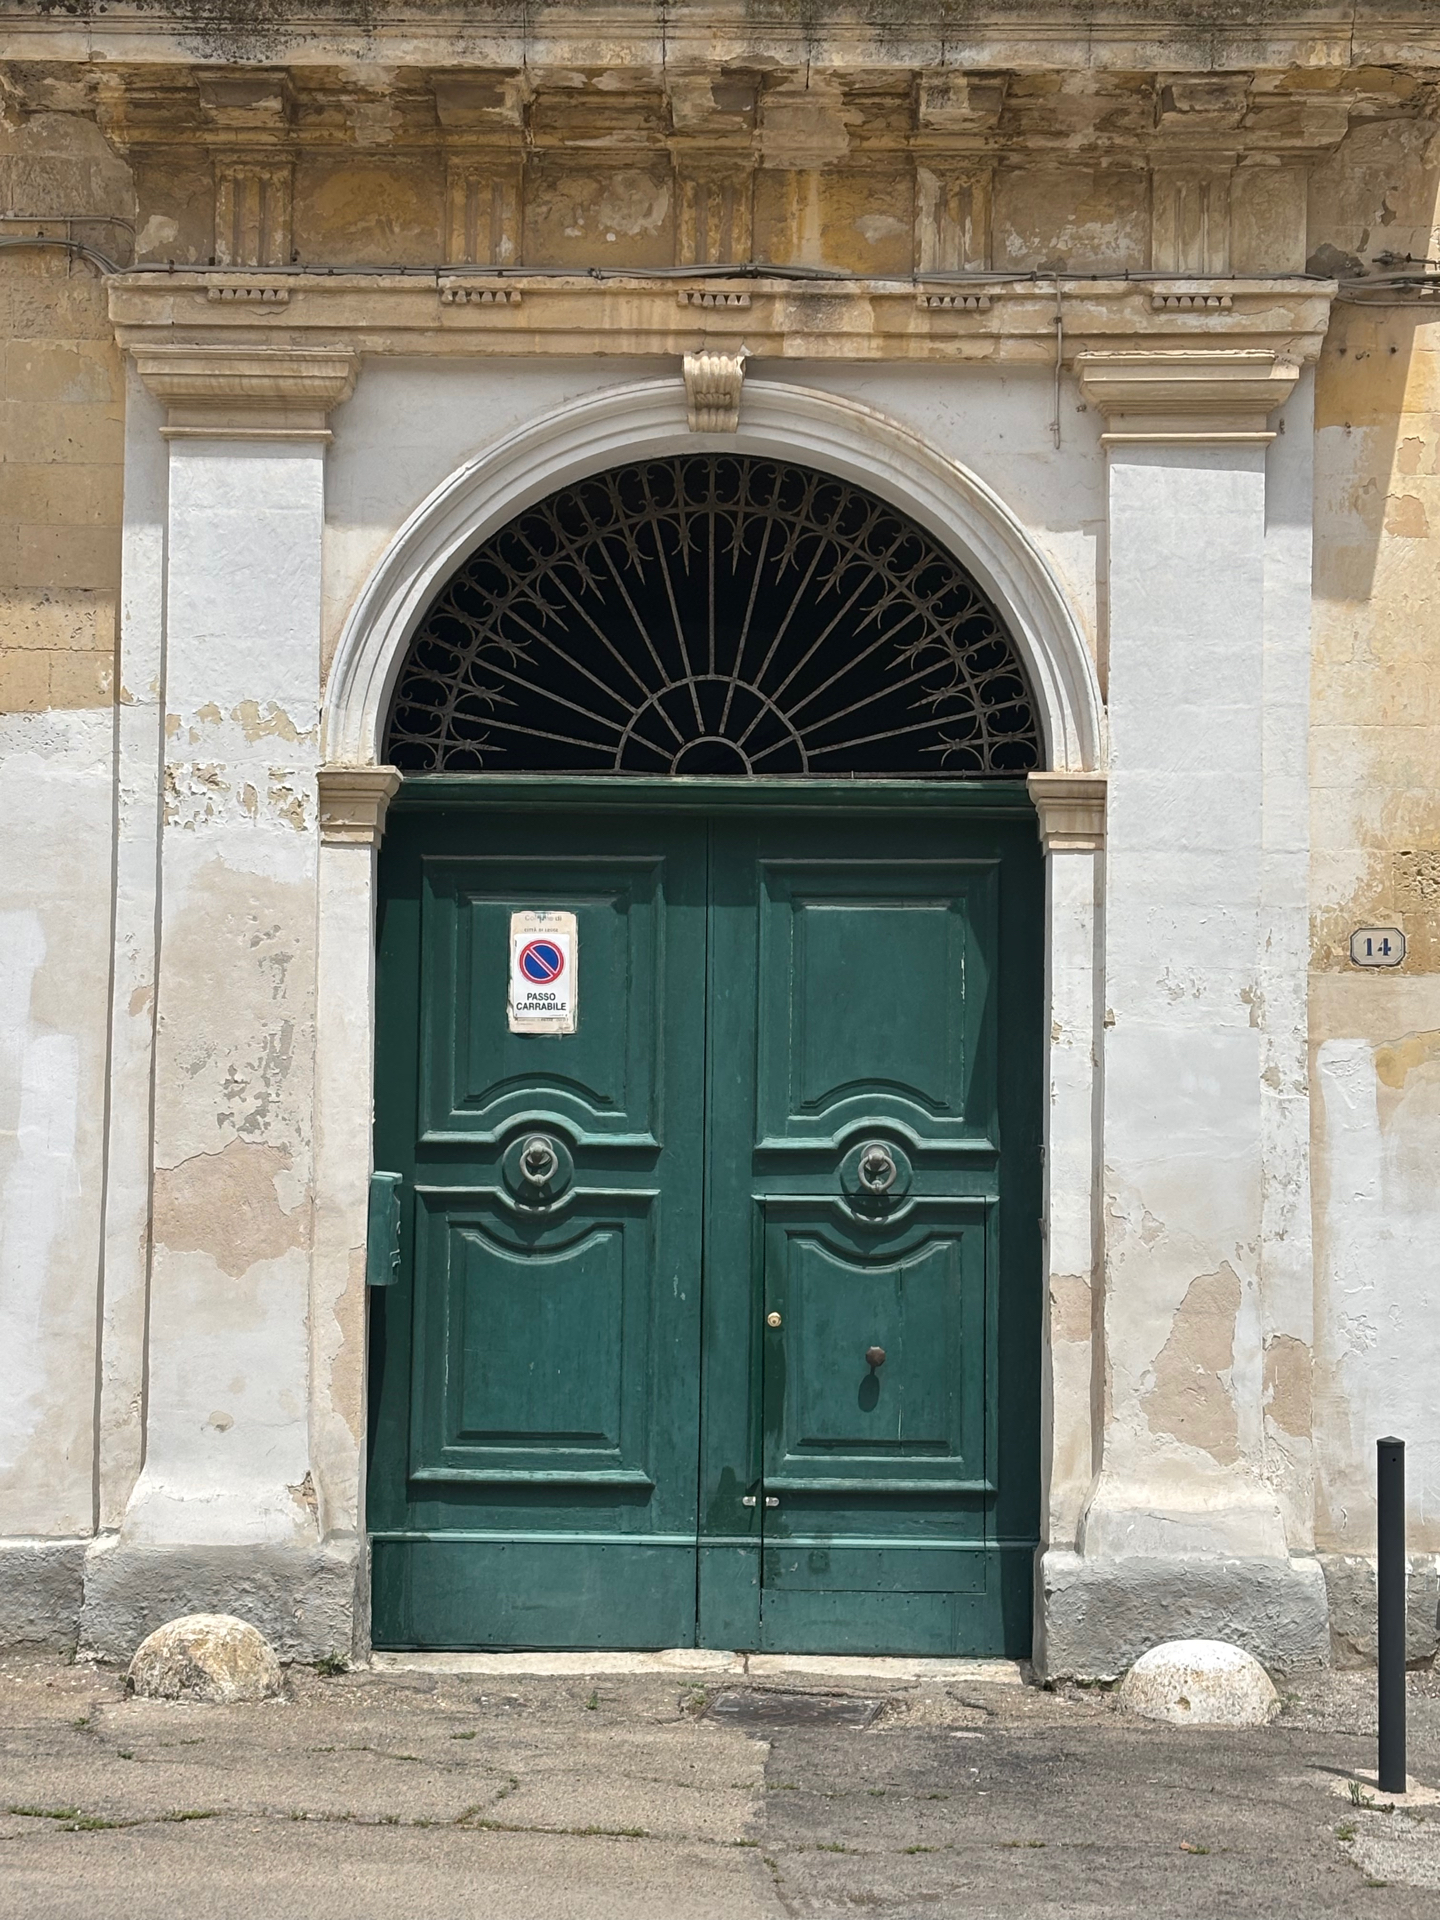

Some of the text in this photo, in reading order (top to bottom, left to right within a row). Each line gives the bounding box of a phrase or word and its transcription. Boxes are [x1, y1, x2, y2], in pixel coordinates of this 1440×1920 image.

[1363, 938, 1391, 956] 14
[526, 992, 556, 1001] PASSO
[516, 1002, 567, 1011] CARRABILE
